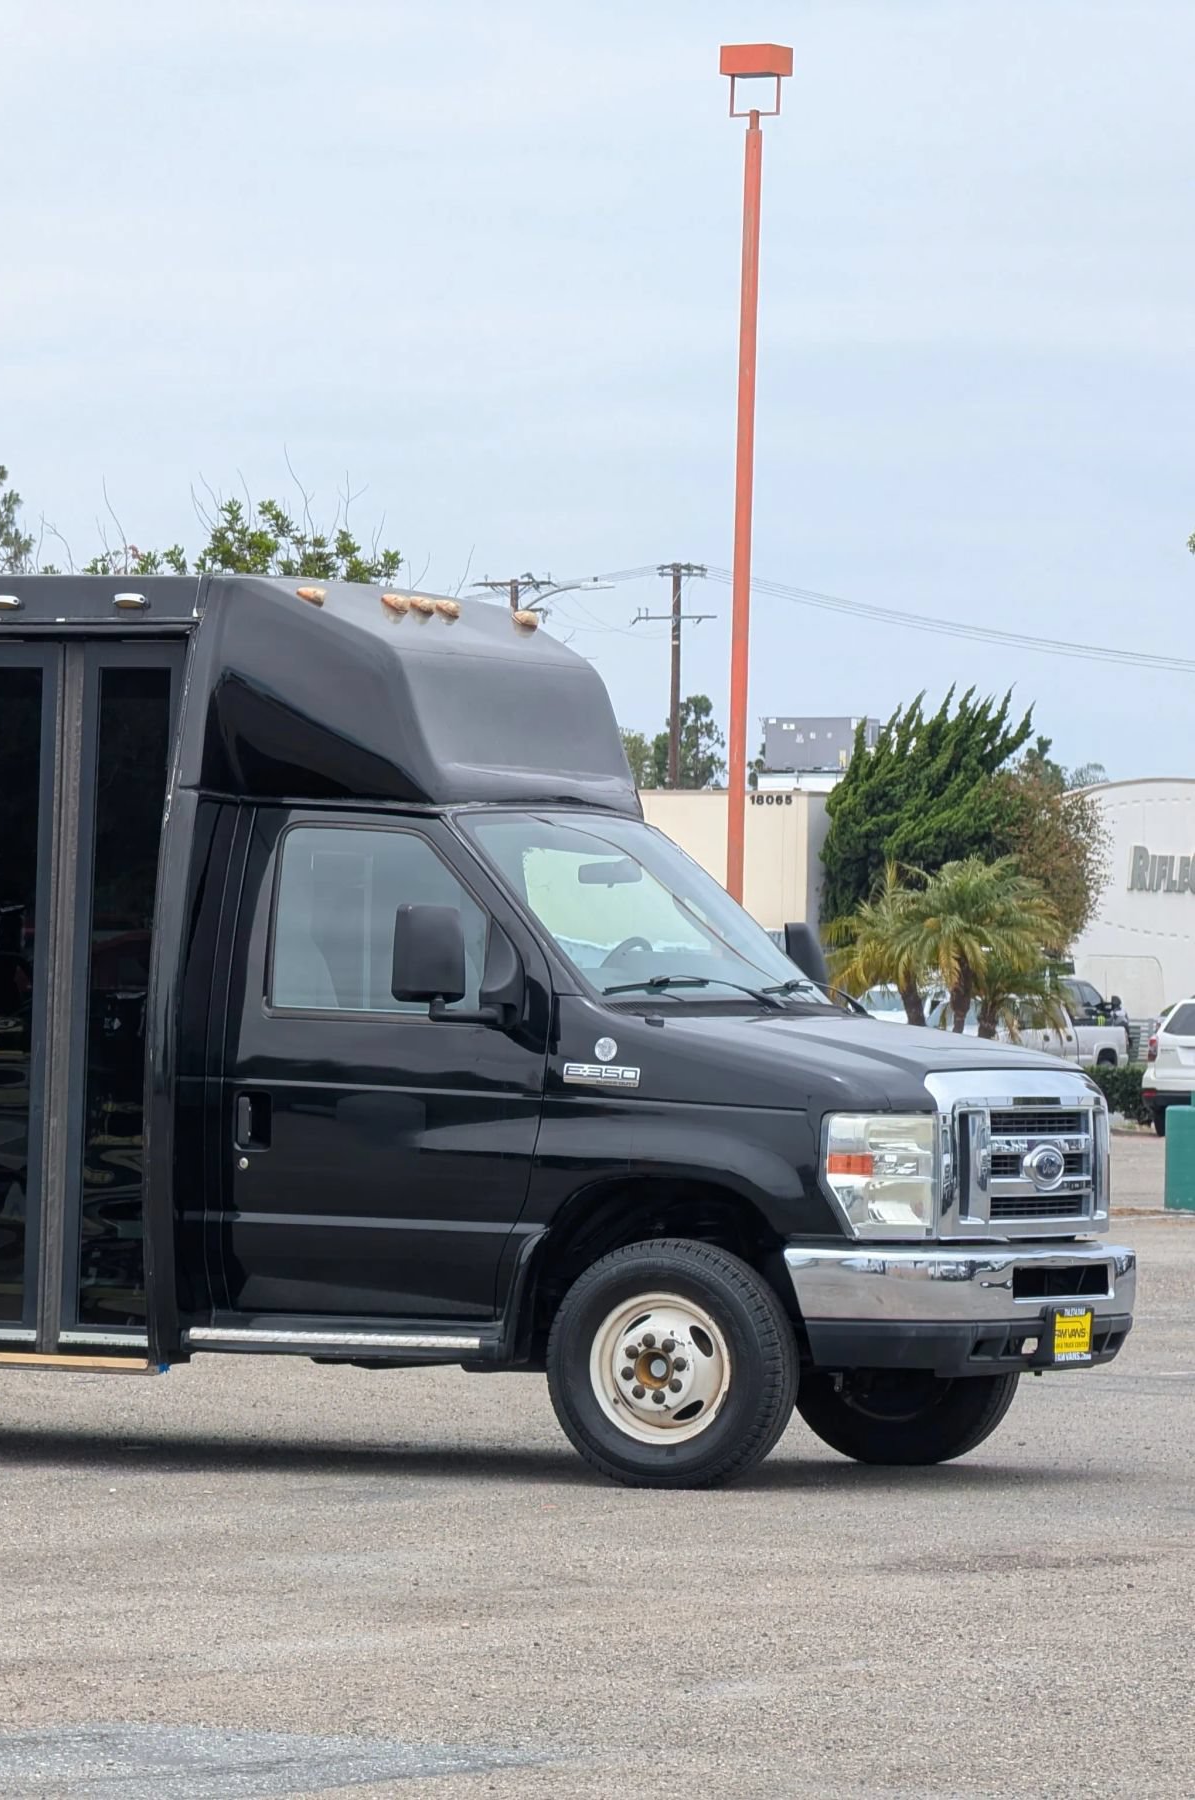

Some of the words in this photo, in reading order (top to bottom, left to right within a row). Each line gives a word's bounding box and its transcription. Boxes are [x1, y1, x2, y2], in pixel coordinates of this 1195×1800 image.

[749, 794, 793, 806] 18065
[1128, 845, 1195, 895] RIFLE
[565, 1065, 639, 1081] E-350
